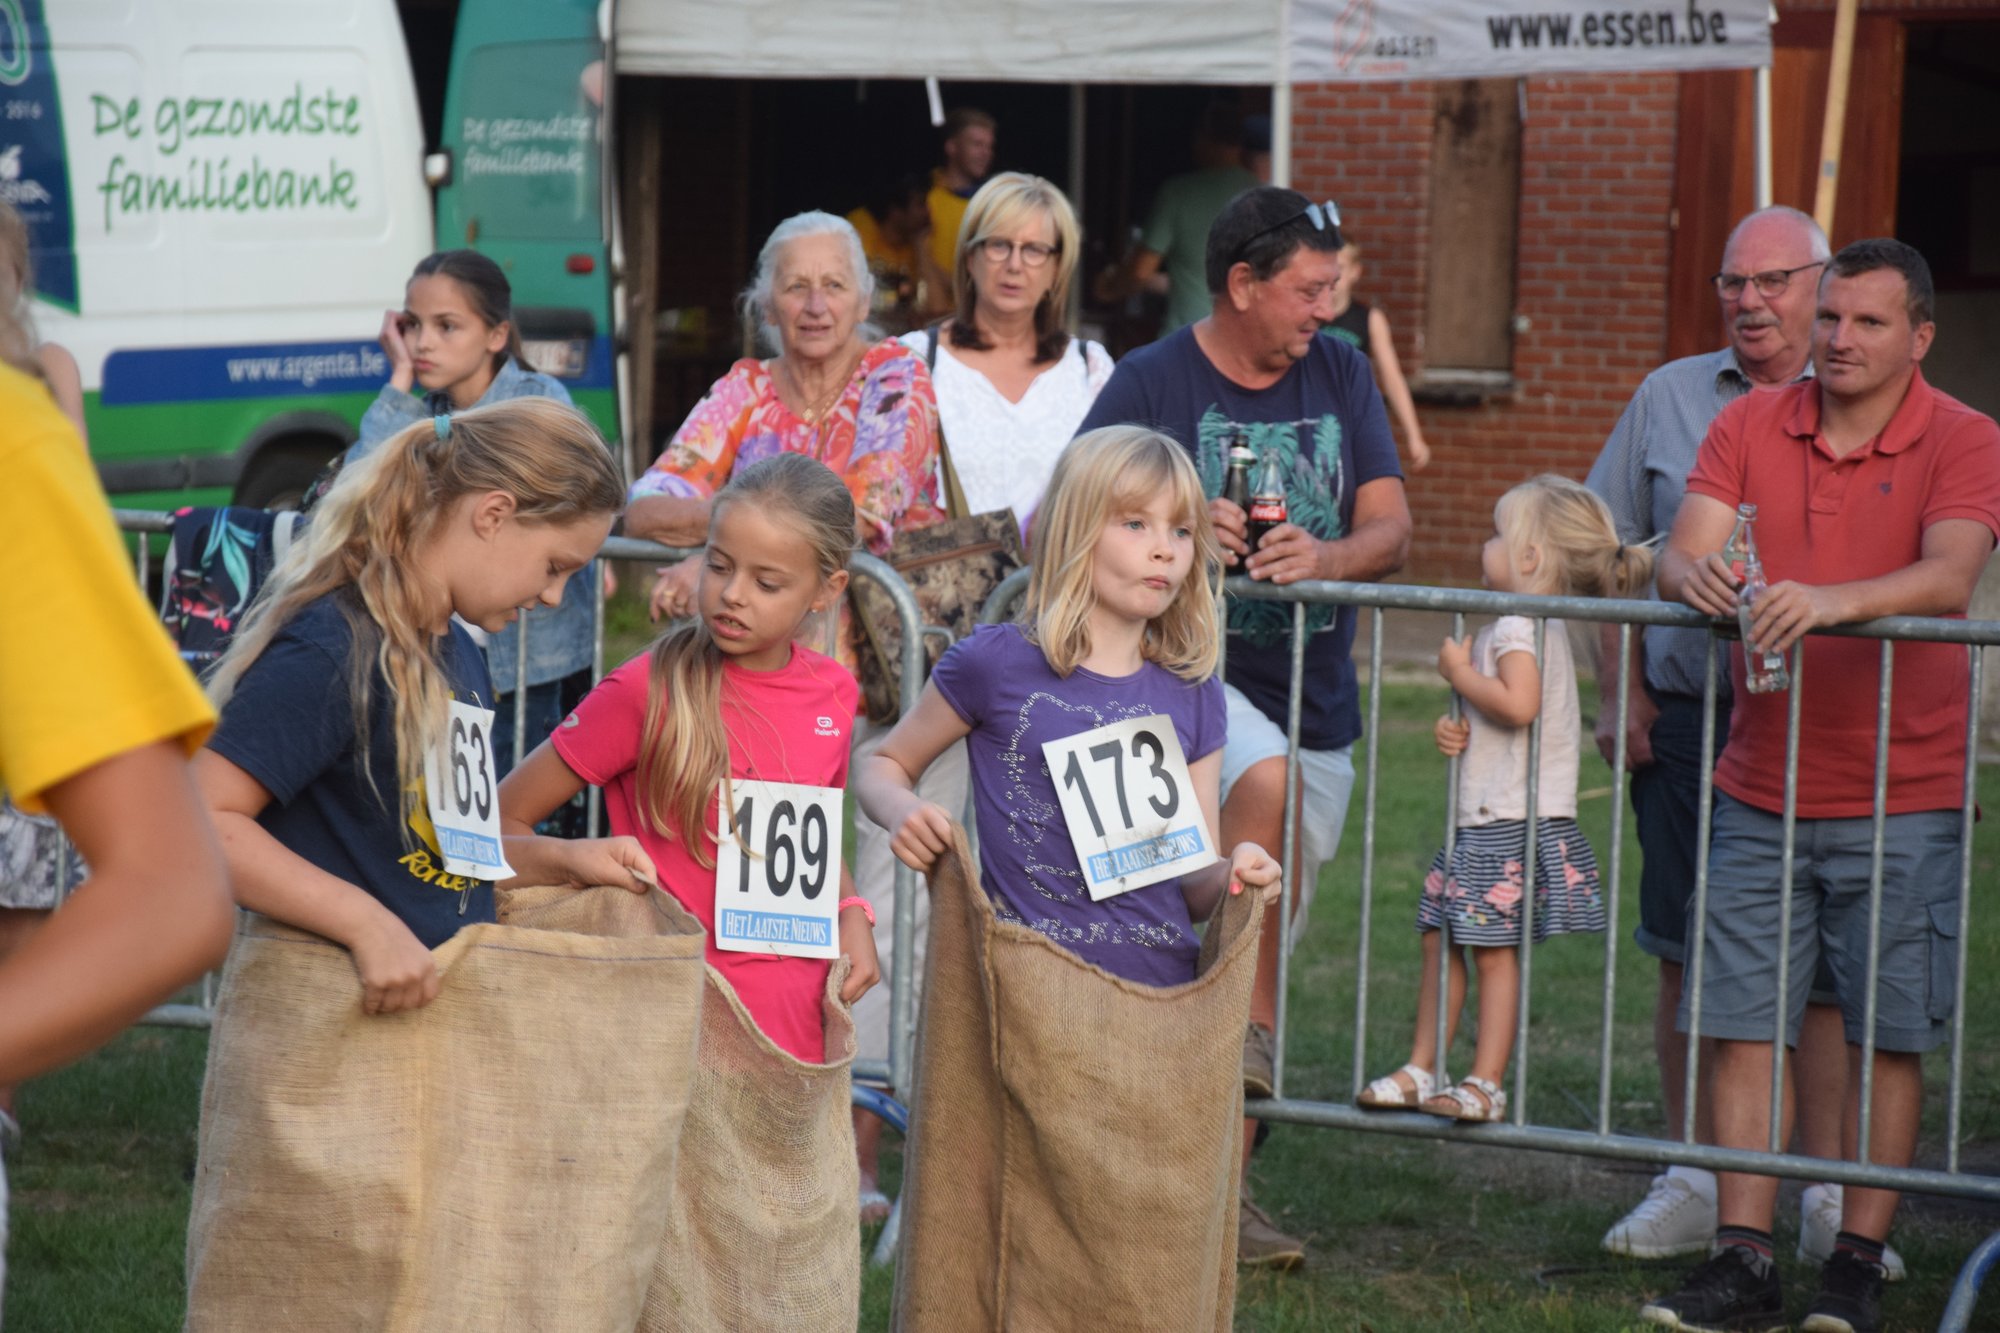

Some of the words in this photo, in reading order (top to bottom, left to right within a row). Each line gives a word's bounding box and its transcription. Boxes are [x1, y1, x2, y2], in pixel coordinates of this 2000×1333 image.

[1487, 0, 1729, 48] www.essen.be
[90, 92, 141, 139] De
[155, 81, 360, 155] gezondste
[463, 117, 487, 143] De
[488, 112, 591, 149] gezondste
[463, 146, 585, 183] familiebank
[97, 154, 358, 234] familiebank
[226, 346, 385, 388] www.argenta.be
[1063, 730, 1180, 838] 173
[728, 796, 829, 900] 169
[725, 911, 750, 937] HET
[748, 914, 790, 941] LAATSTE
[790, 917, 827, 945] NIEUWS
